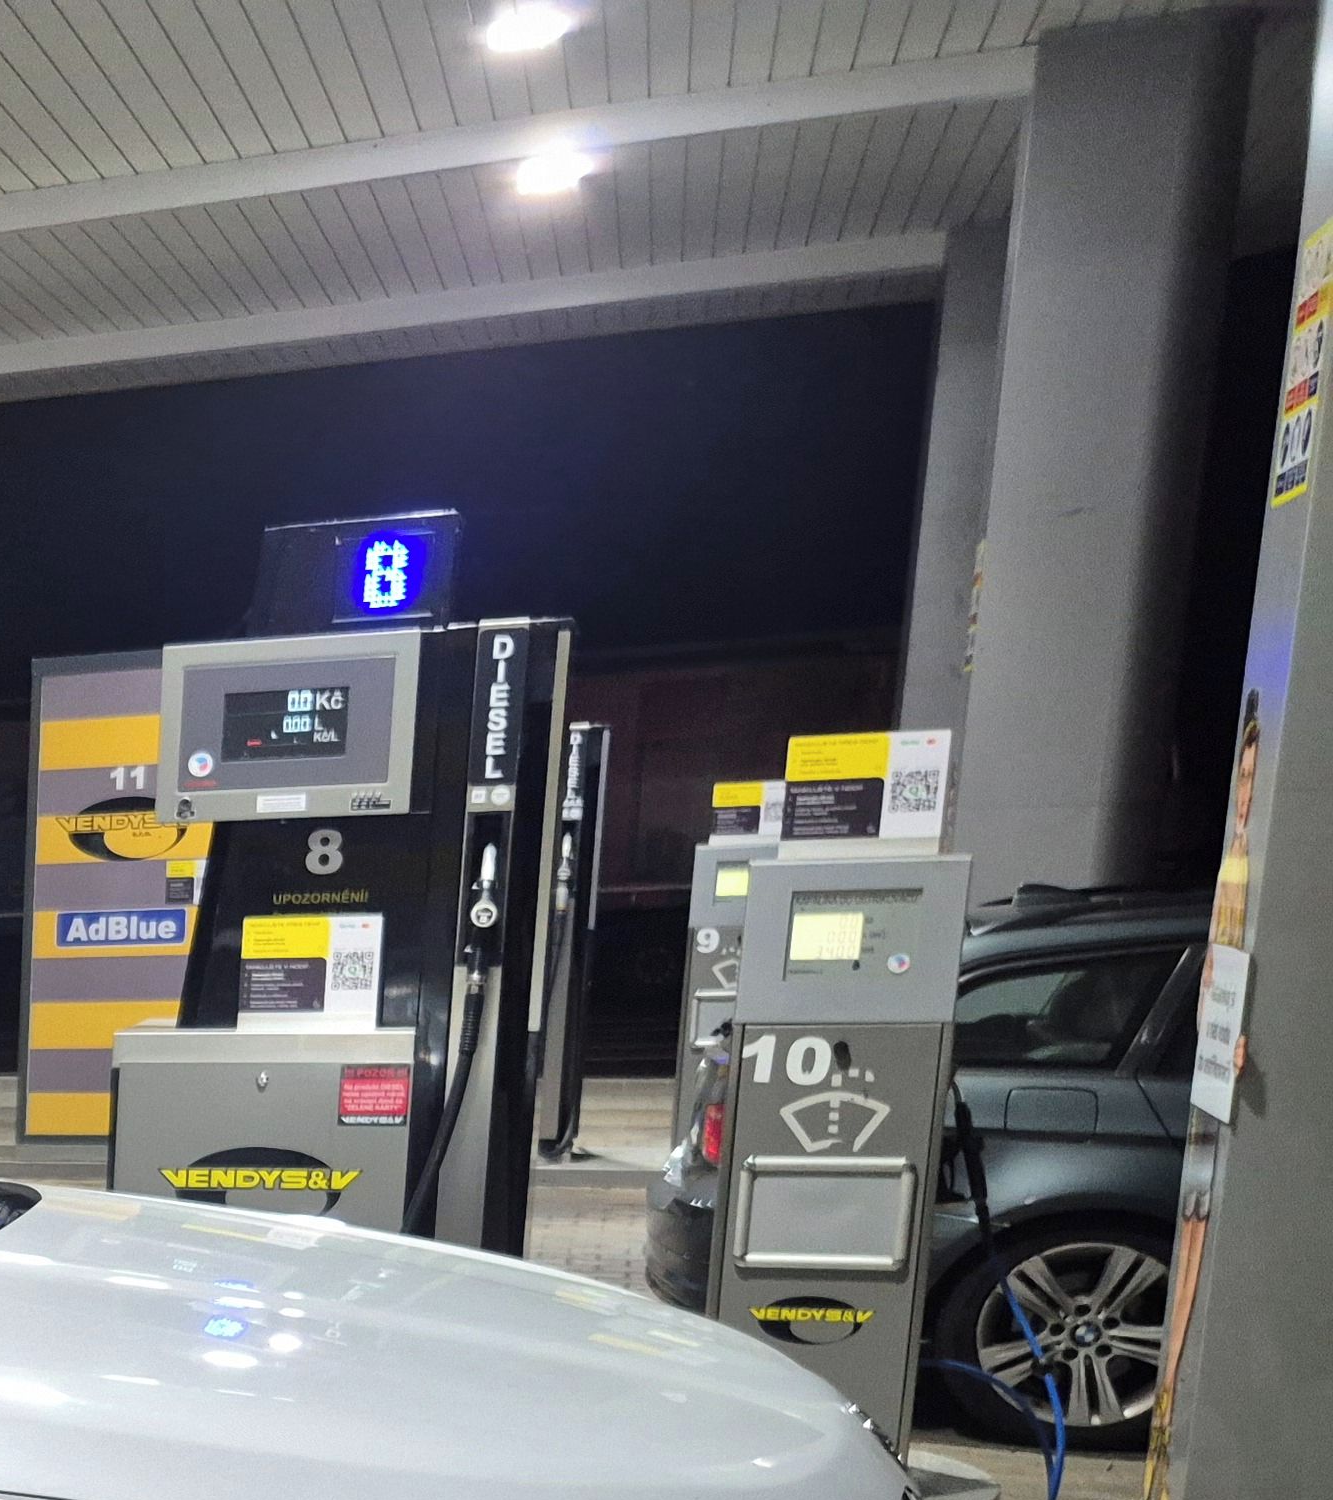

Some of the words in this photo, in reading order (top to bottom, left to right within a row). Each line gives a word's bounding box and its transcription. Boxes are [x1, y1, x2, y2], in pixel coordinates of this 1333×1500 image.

[363, 540, 410, 609] 8
[484, 633, 515, 780] DIESEL
[110, 765, 146, 791] 11
[55, 813, 187, 832] VENDYS
[305, 829, 343, 875] 8
[66, 914, 177, 942] AdBlue
[696, 928, 720, 954] 9
[742, 1034, 832, 1086] 10
[159, 1167, 363, 1191] VENDYS&V
[748, 1306, 875, 1324] VENDYS&V
